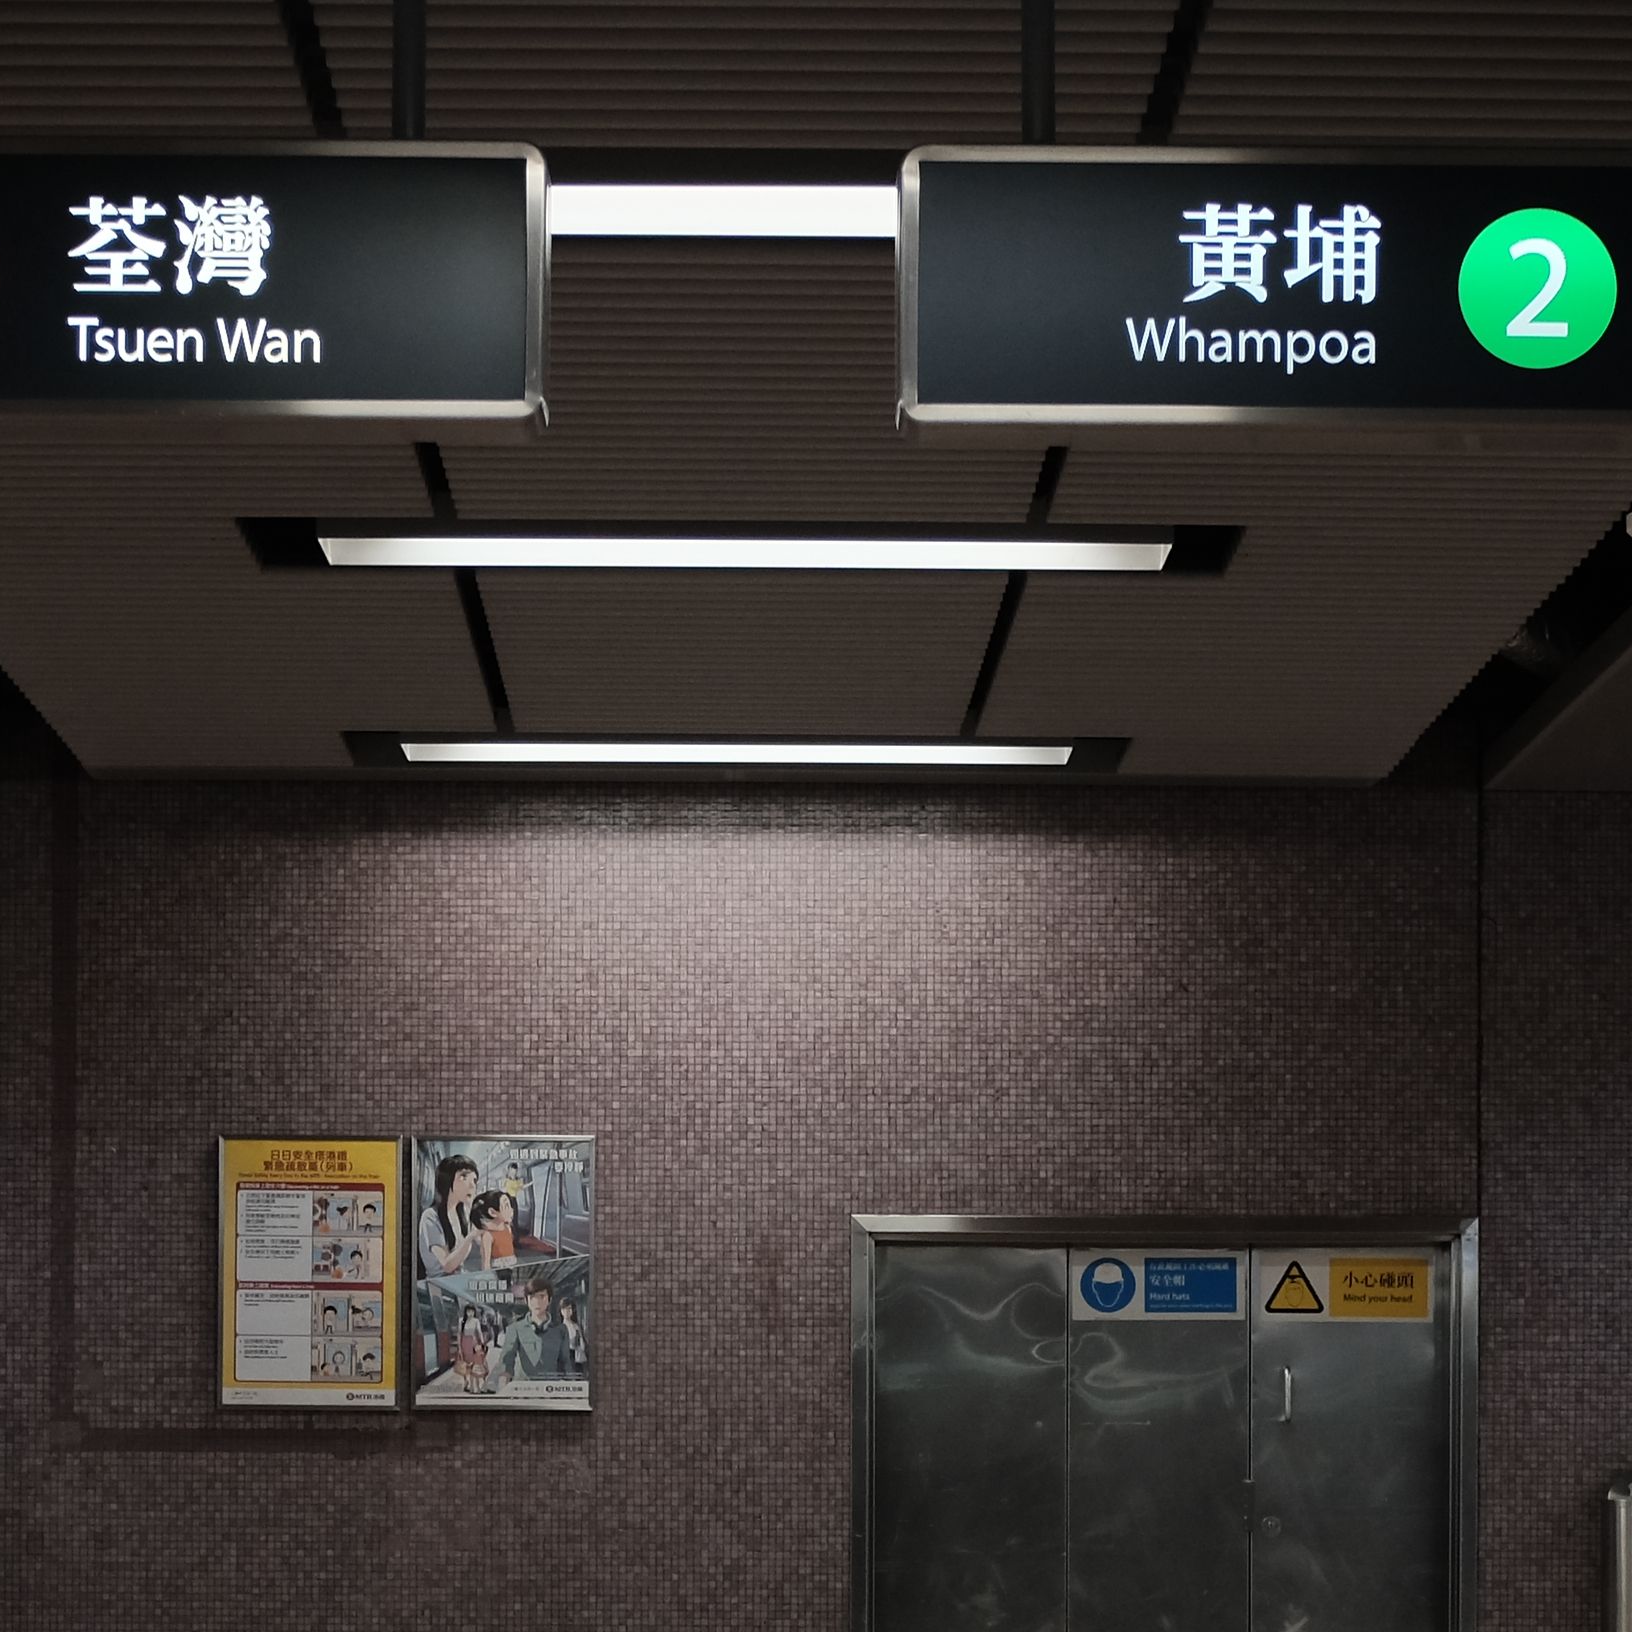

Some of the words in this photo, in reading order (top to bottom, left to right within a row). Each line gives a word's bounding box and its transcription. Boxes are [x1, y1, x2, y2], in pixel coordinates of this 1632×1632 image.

[67, 194, 271, 300] 荃灣
[1179, 203, 1382, 305] 黃埔
[1506, 236, 1571, 338] 2
[68, 316, 204, 363] Tsuen
[218, 319, 322, 364] Wan
[1125, 316, 1377, 374] Whampoa
[1342, 1270, 1415, 1289] 小心碰頭
[1343, 1293, 1366, 1303] Mind
[1368, 1295, 1388, 1304] your
[1390, 1293, 1413, 1303] head
